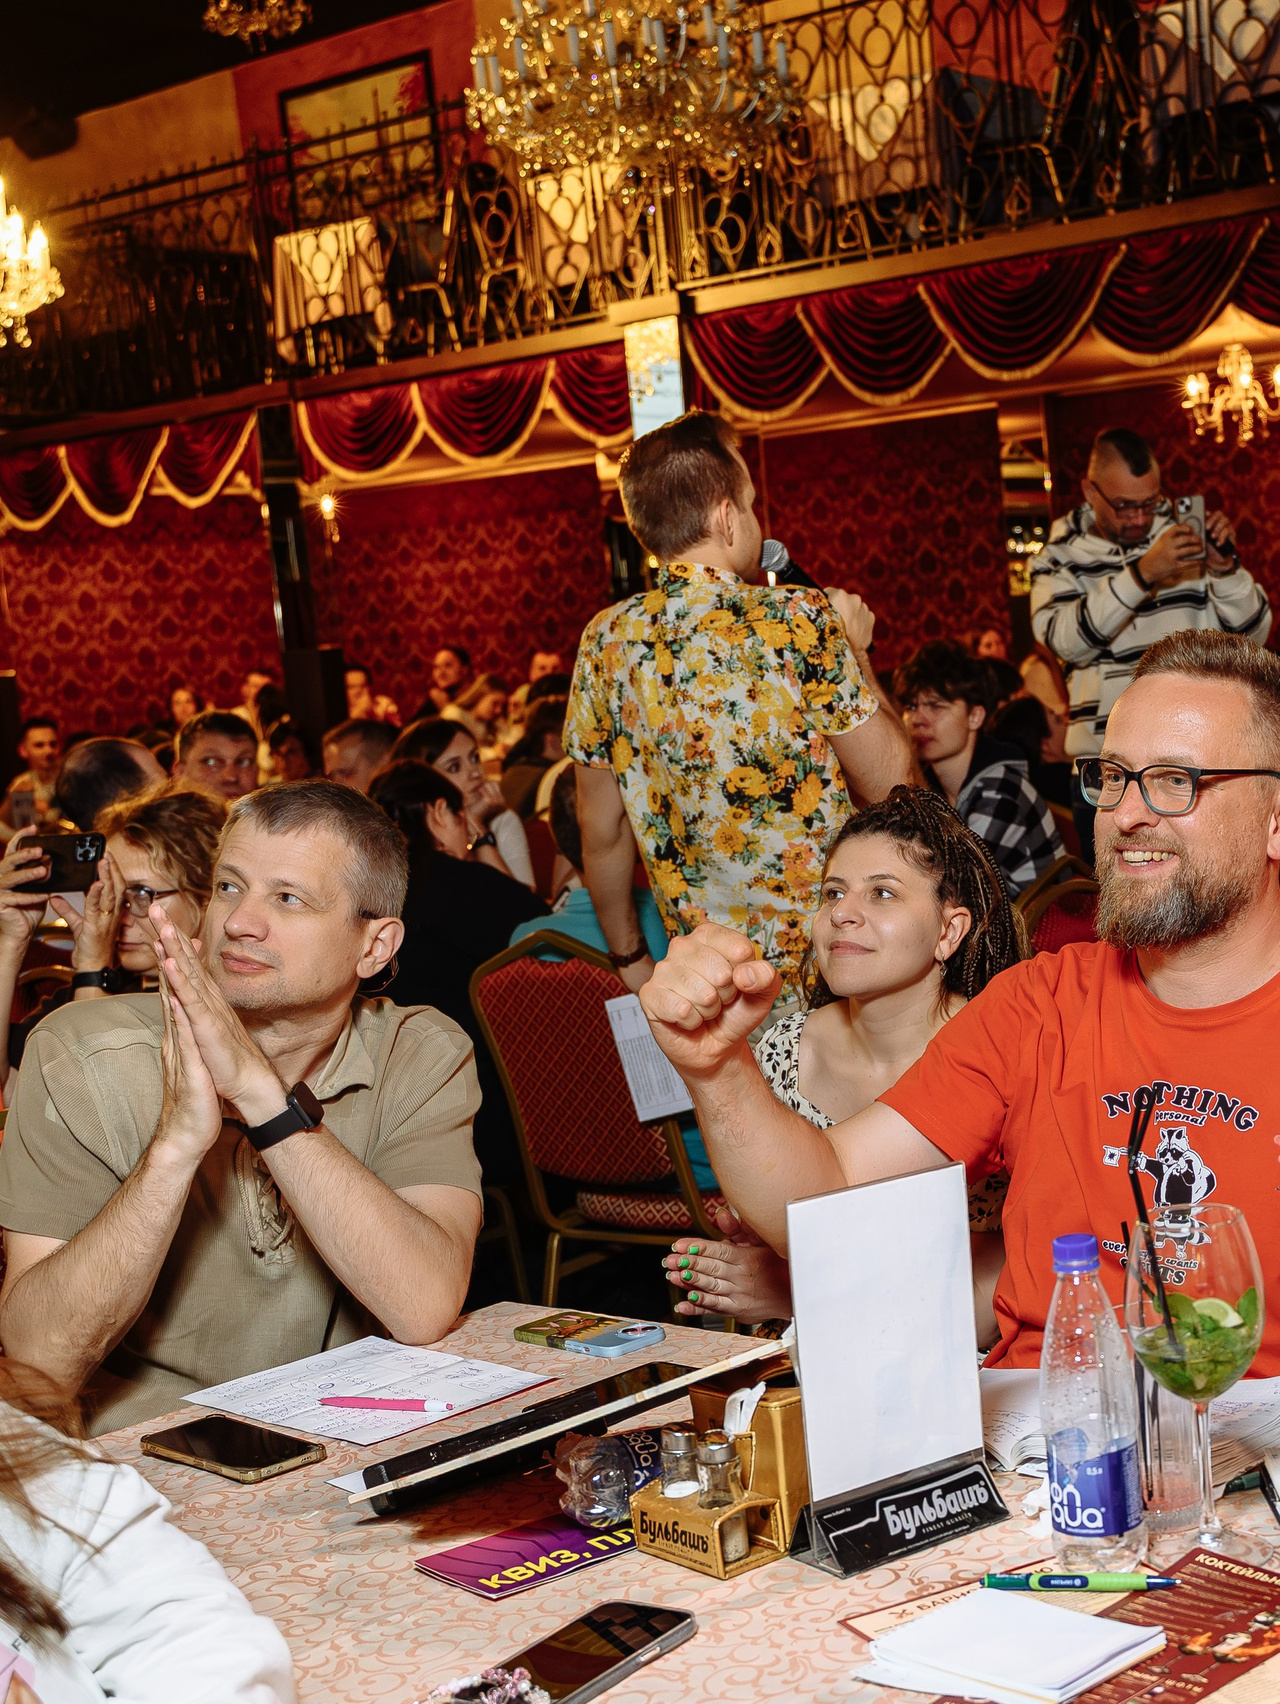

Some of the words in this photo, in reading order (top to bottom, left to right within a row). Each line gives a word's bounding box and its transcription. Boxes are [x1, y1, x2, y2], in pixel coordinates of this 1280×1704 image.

[1102, 1081, 1259, 1131] NOTHING
[1154, 1110, 1207, 1127] personal
[1165, 1257, 1198, 1270] wants
[882, 1482, 989, 1540] Бульбашъ
[640, 1511, 709, 1554] Бульбашъ
[478, 1549, 592, 1589] КВИЗ,
